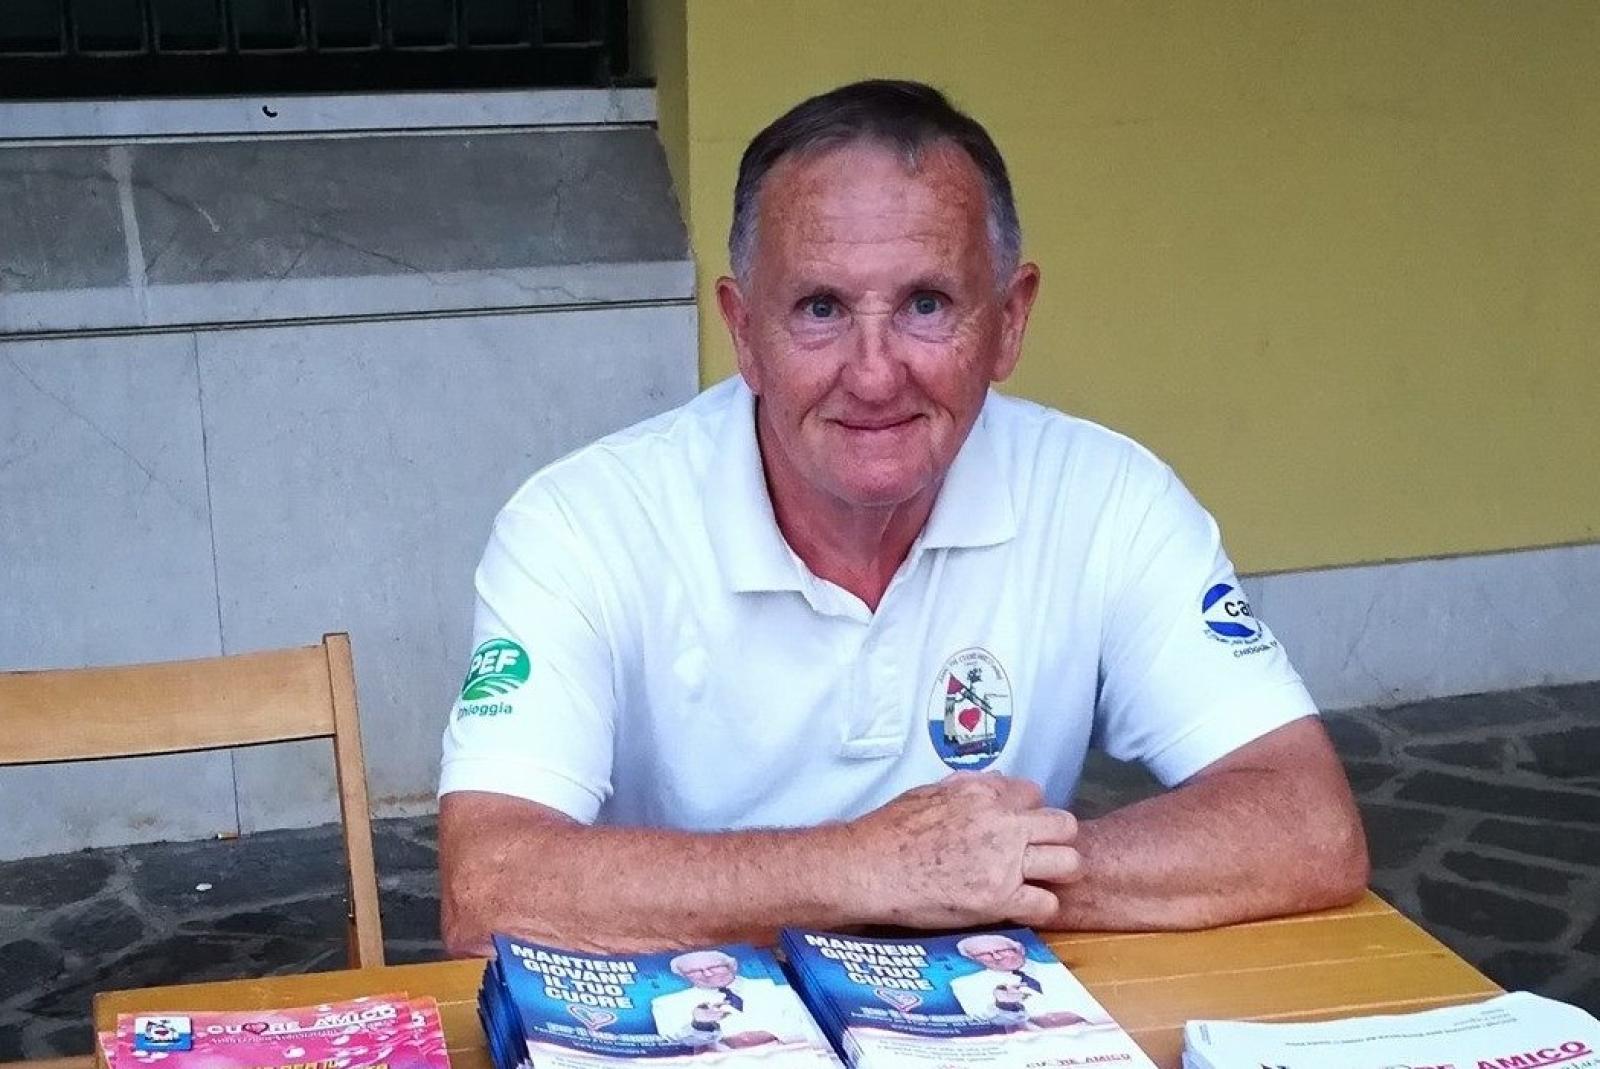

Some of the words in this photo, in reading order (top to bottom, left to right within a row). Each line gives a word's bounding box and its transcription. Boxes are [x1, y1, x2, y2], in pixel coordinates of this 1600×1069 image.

[1224, 600, 1254, 618] ca
[804, 934, 927, 956] MANTIENI
[510, 943, 638, 974] MANTIENI
[820, 947, 930, 968] GIOVANE
[522, 958, 636, 985] GIOVANE
[843, 961, 870, 974] IL
[868, 964, 921, 979] TUO
[848, 972, 934, 991] CUORE
[543, 974, 570, 990] IL
[570, 980, 624, 997] TUO
[544, 986, 634, 1009] CUORE
[314, 1004, 397, 1028] AMICO
[1476, 1040, 1586, 1069] AMICO
